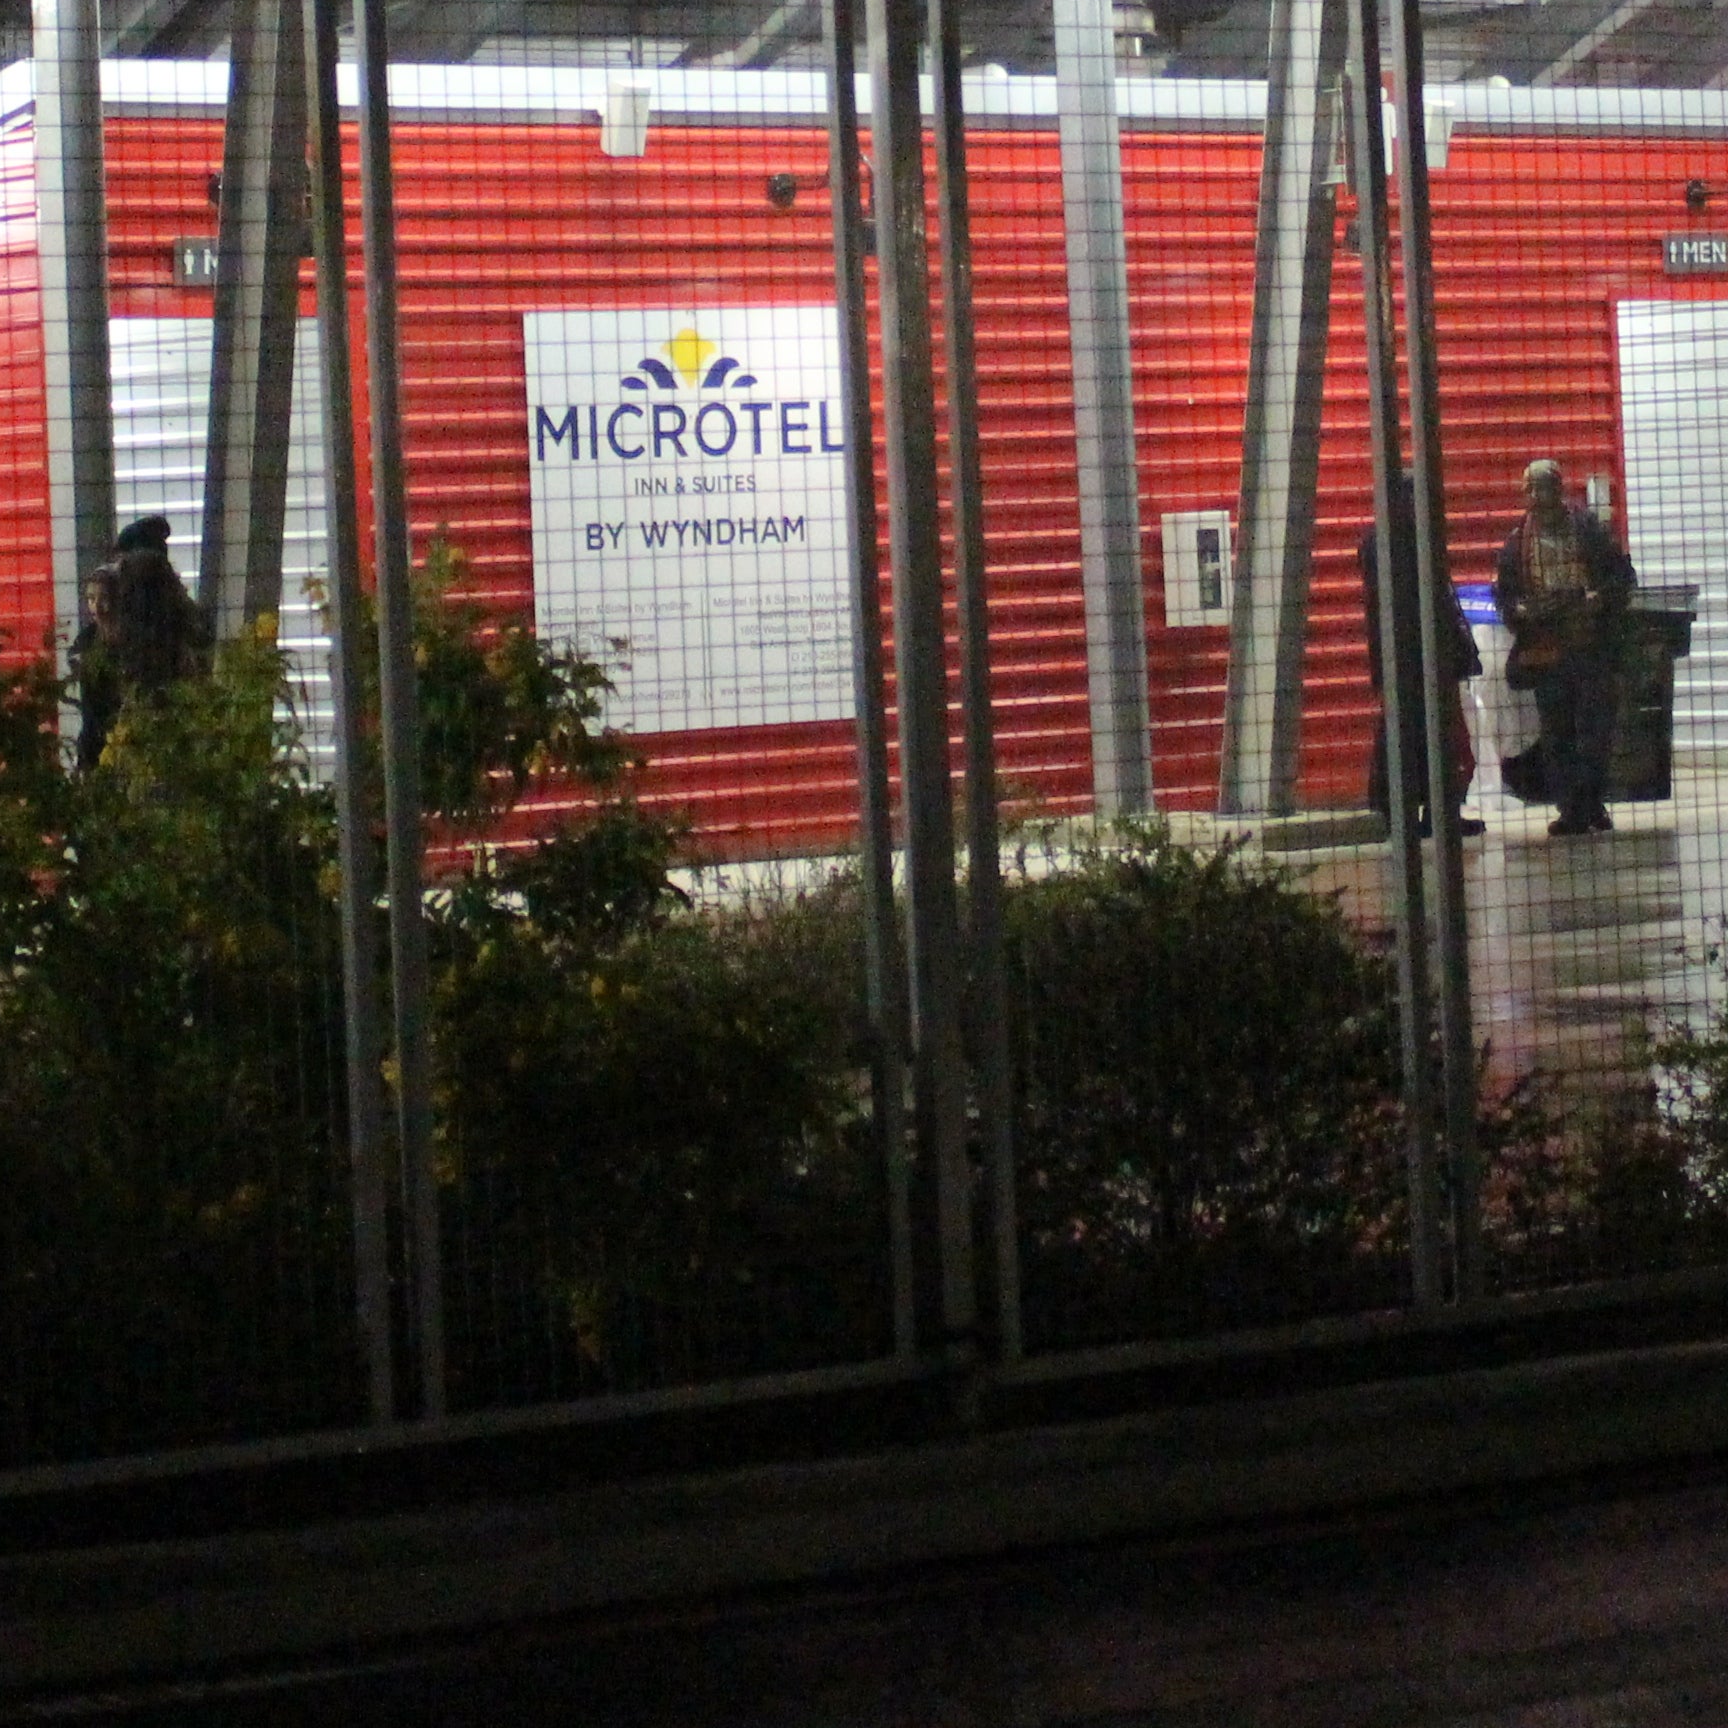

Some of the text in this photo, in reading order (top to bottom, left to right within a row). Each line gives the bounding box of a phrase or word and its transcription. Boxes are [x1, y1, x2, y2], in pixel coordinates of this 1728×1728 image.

[1682, 241, 1727, 264] MEN
[535, 400, 846, 462] MICROTEL
[634, 474, 757, 496] INN & SUITES
[586, 515, 805, 551] BY WYNDHAM
